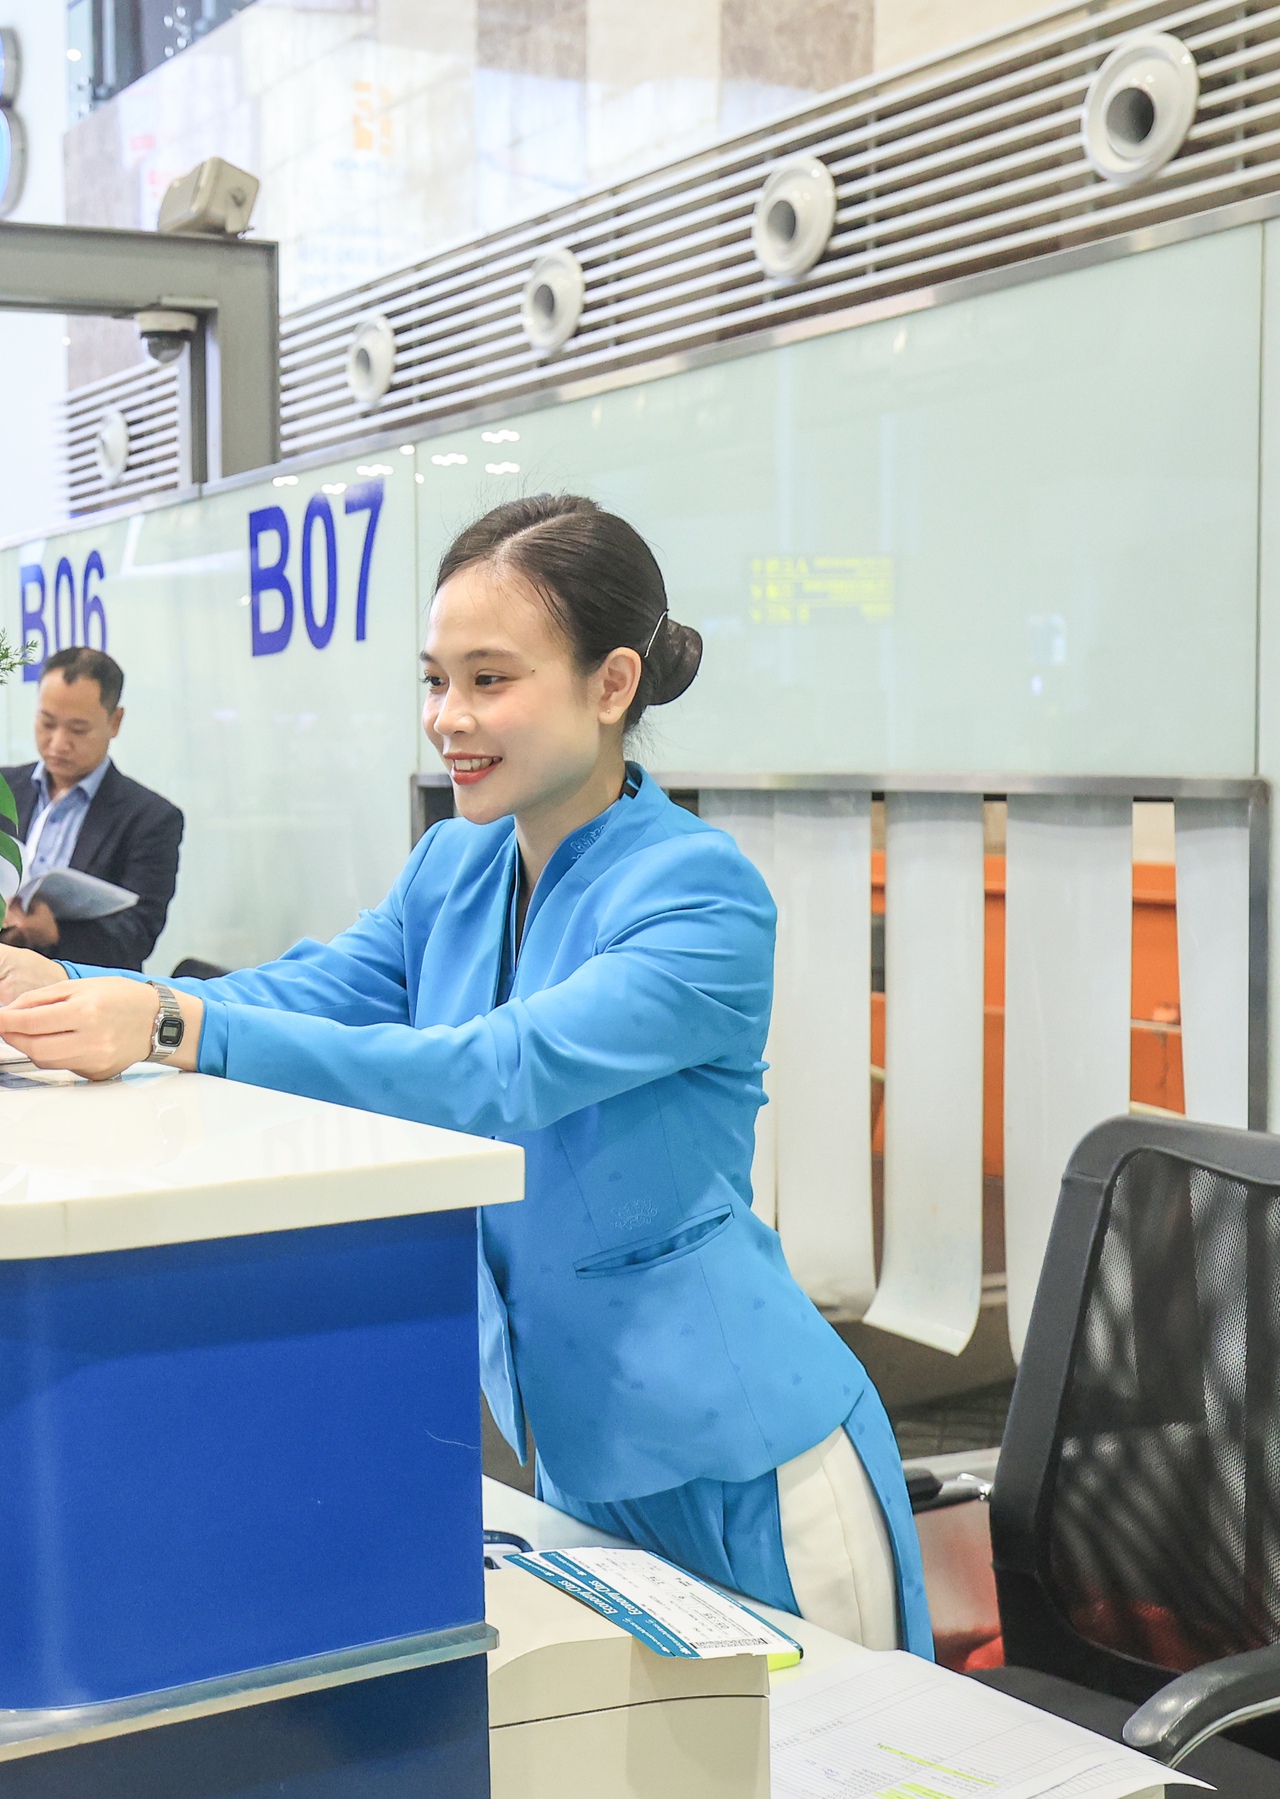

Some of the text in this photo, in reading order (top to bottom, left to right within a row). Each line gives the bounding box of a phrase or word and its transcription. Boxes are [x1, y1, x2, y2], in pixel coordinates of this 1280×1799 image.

[248, 478, 384, 657] B07
[20, 550, 108, 682] B06
[558, 1580, 619, 1614] Economy Class
[588, 1580, 611, 1593] Class
[605, 1591, 644, 1615] Economy
